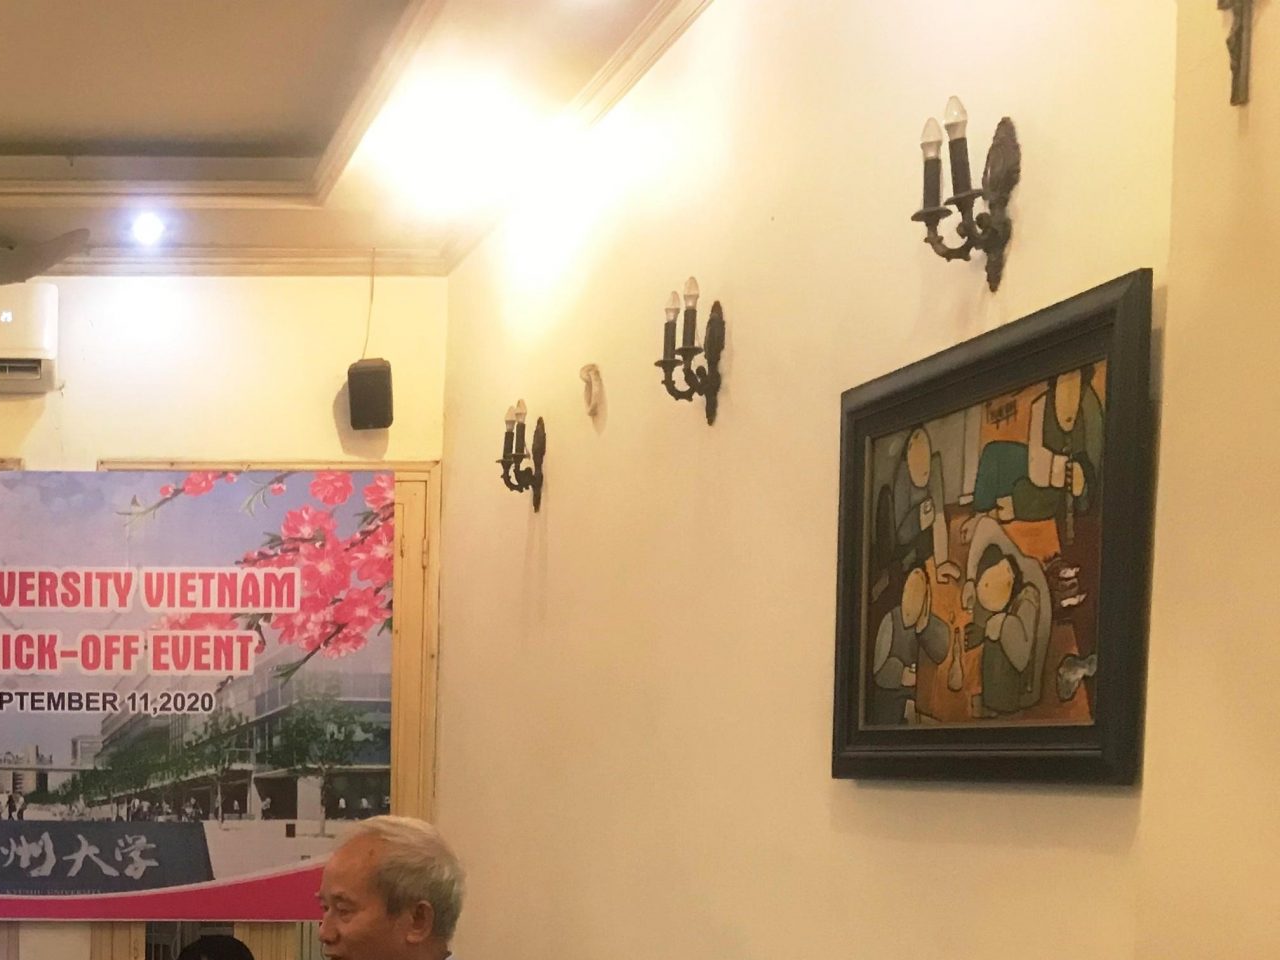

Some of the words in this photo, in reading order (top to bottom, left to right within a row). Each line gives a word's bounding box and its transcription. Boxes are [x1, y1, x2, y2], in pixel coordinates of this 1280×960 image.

[144, 571, 296, 608] VIETNAM
[152, 634, 253, 671] EVENT
[127, 691, 214, 715] 11,2020
